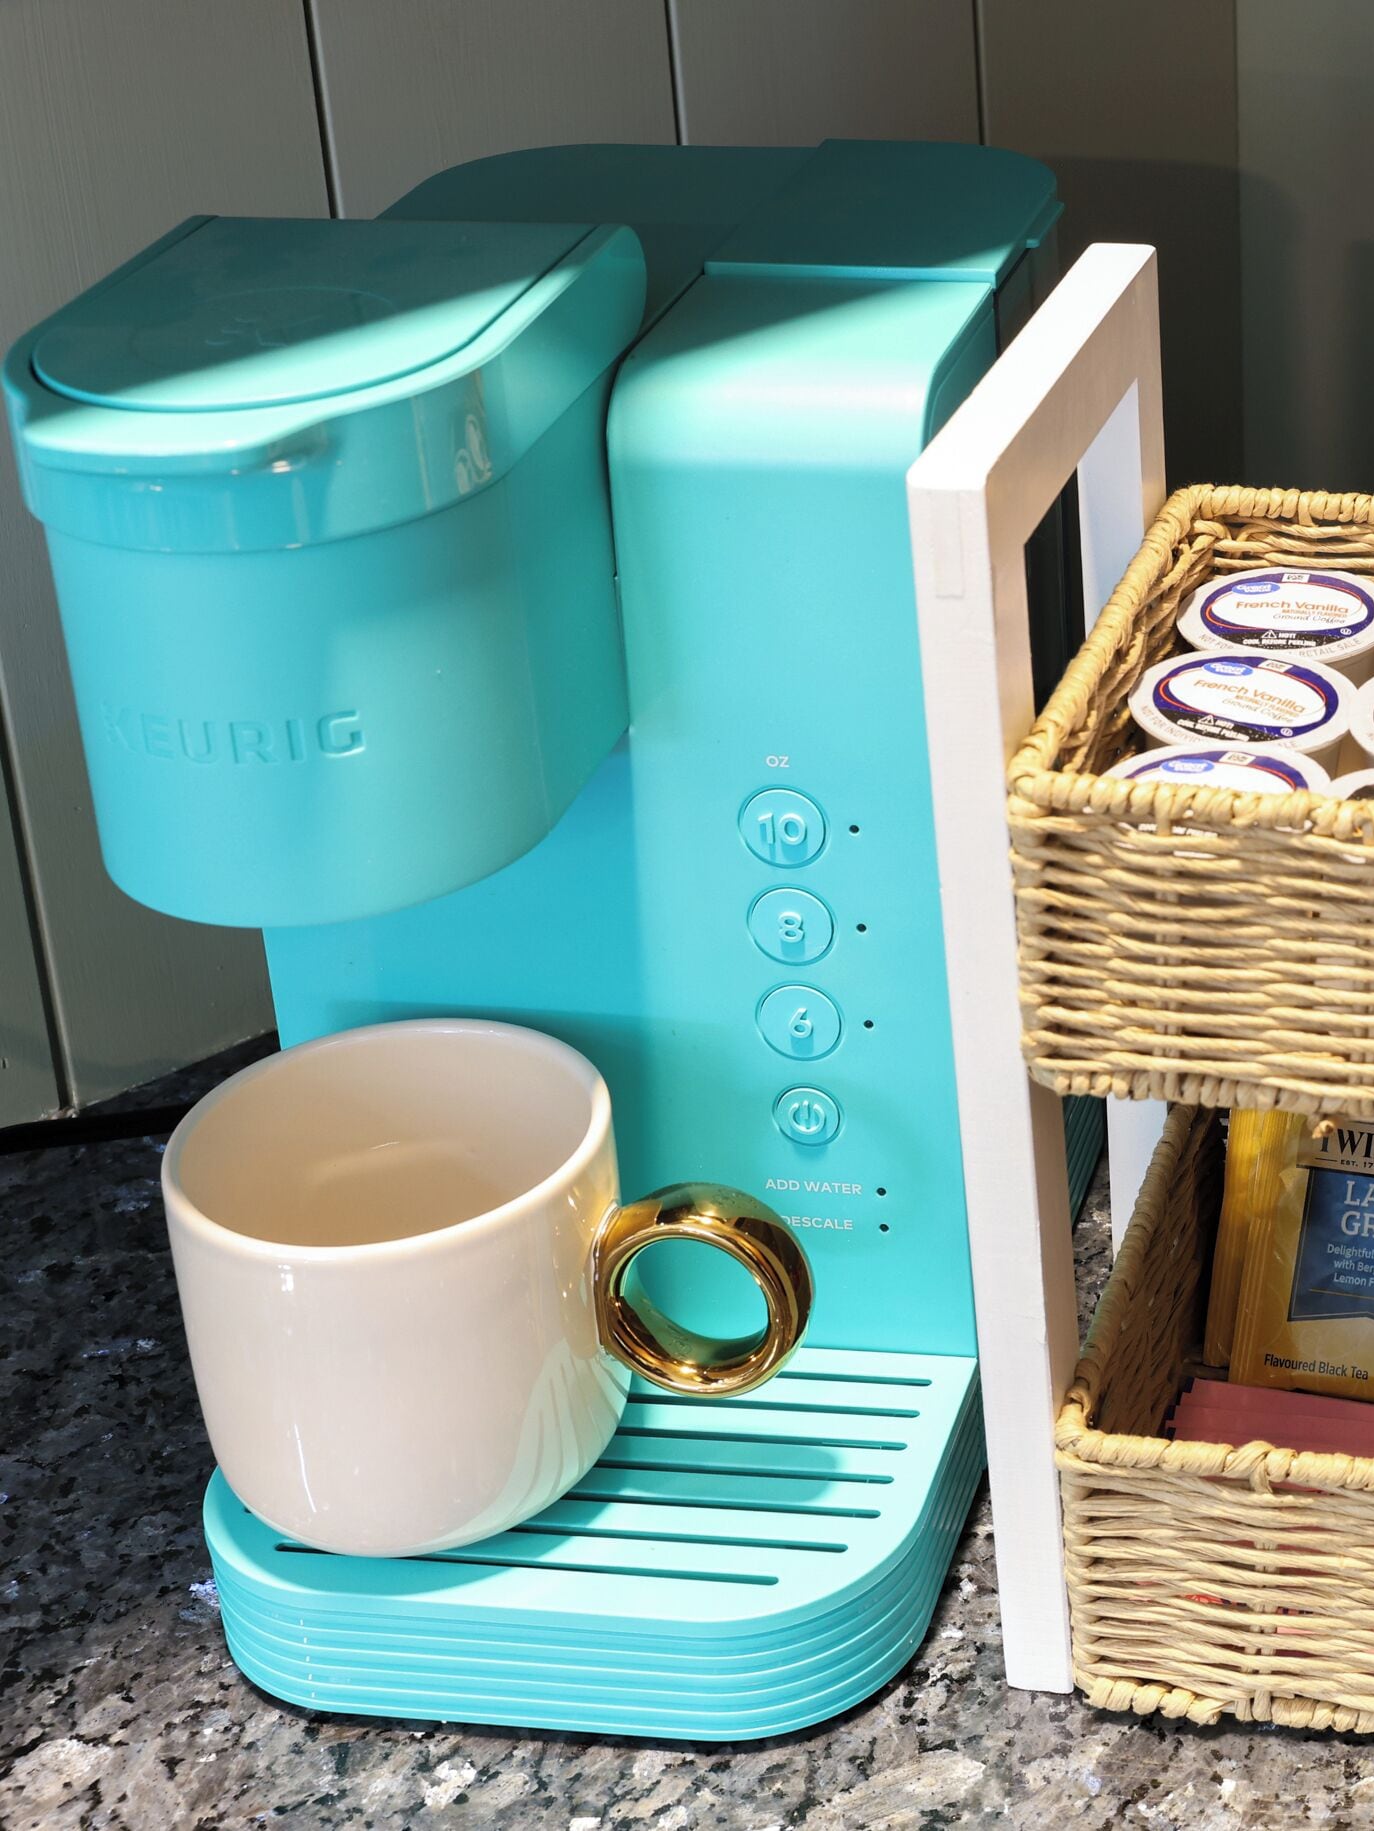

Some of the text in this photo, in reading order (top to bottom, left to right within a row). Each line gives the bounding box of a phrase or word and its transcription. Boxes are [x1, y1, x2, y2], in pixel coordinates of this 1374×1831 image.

[1235, 600, 1349, 613] French Vanilla
[1194, 679, 1306, 714] French Vanilla
[99, 705, 366, 765] KEURIG
[766, 755, 790, 768] OZ
[757, 812, 808, 845] 10
[778, 911, 805, 943] 8
[788, 1008, 813, 1038] 6
[1340, 1159, 1358, 1167] EST.
[765, 1179, 862, 1195] ADD WATER
[1334, 1260, 1355, 1270] with
[1333, 1272, 1367, 1287] Lemon
[1264, 1353, 1369, 1381] Flavoured Black Tea
